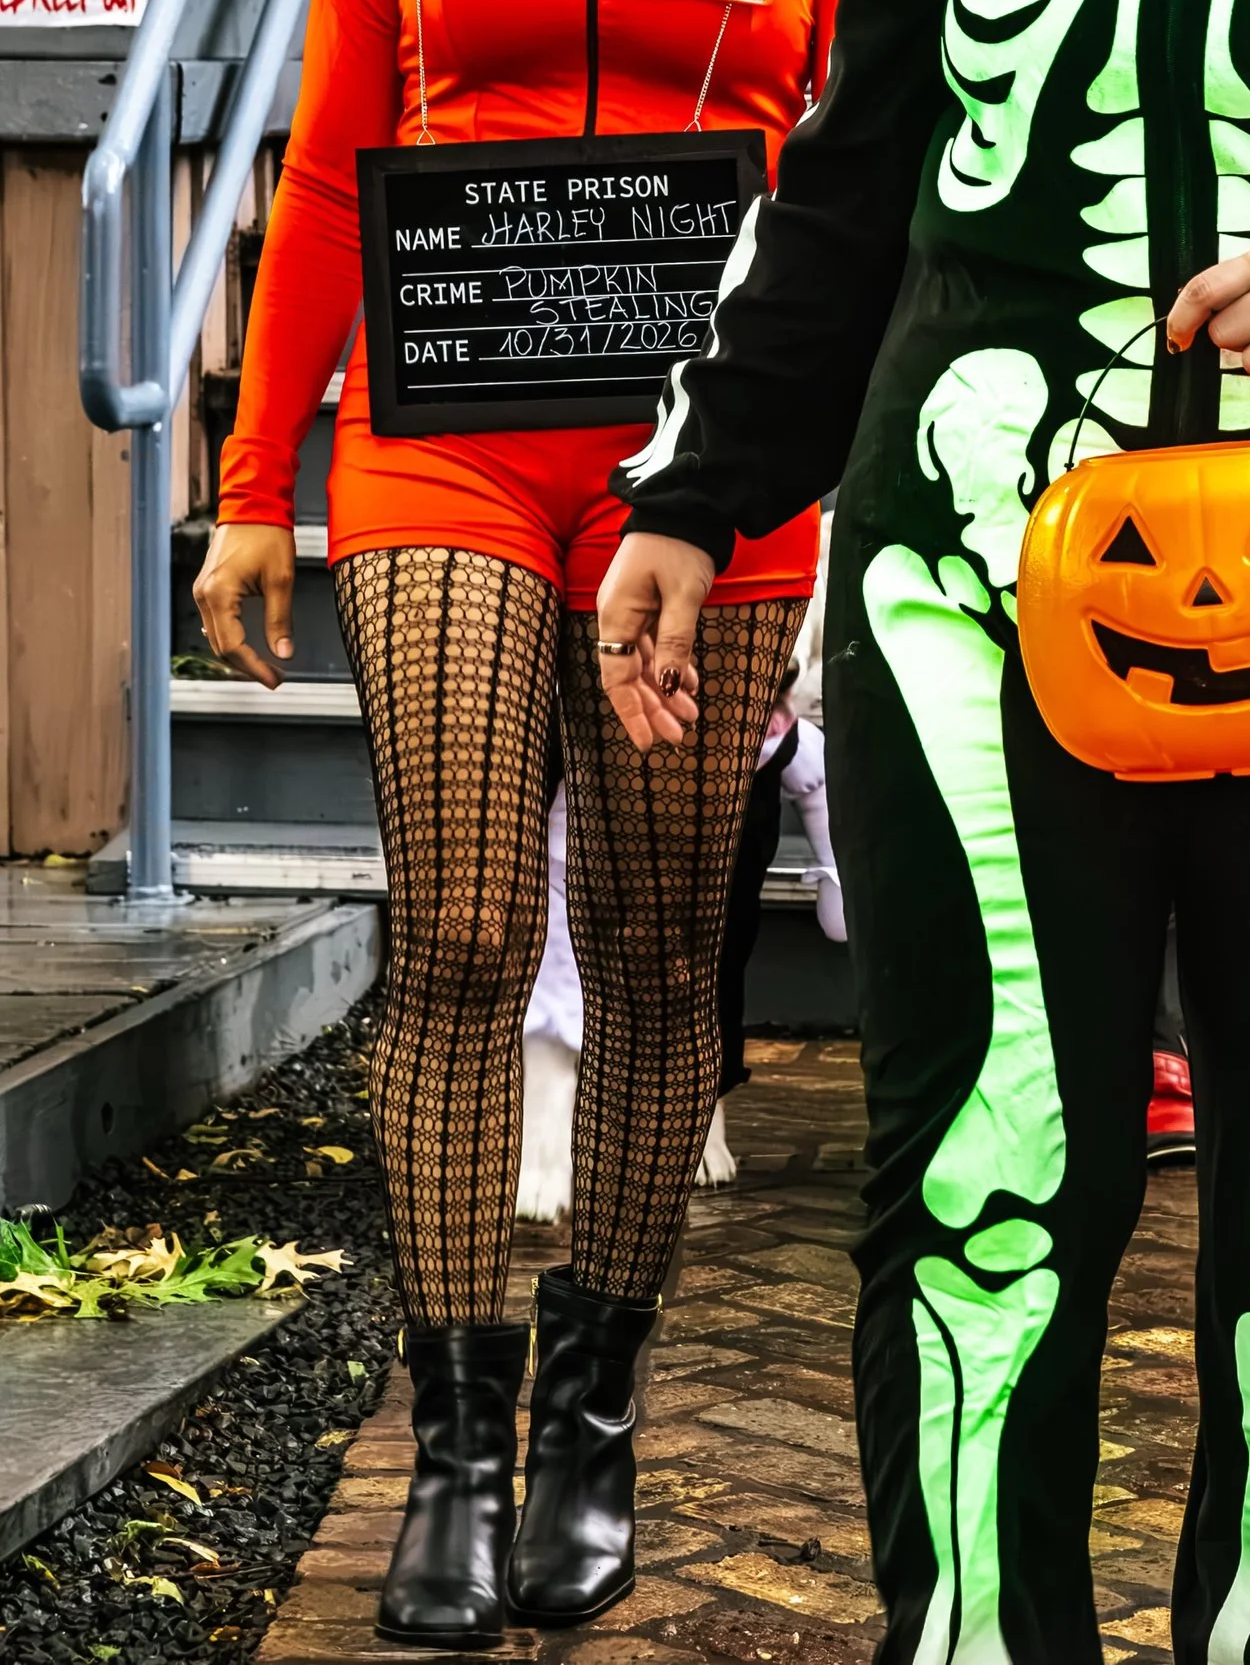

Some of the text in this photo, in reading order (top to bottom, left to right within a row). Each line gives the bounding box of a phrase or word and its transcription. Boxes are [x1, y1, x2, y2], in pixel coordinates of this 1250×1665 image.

[464, 175, 669, 205] STATE PRISON
[396, 201, 737, 252] NAME HARLEY NIGHT
[400, 265, 658, 307] CRIME PUMPKIN
[529, 291, 713, 326] STEALING
[405, 322, 698, 364] DATE 10/31/2026
